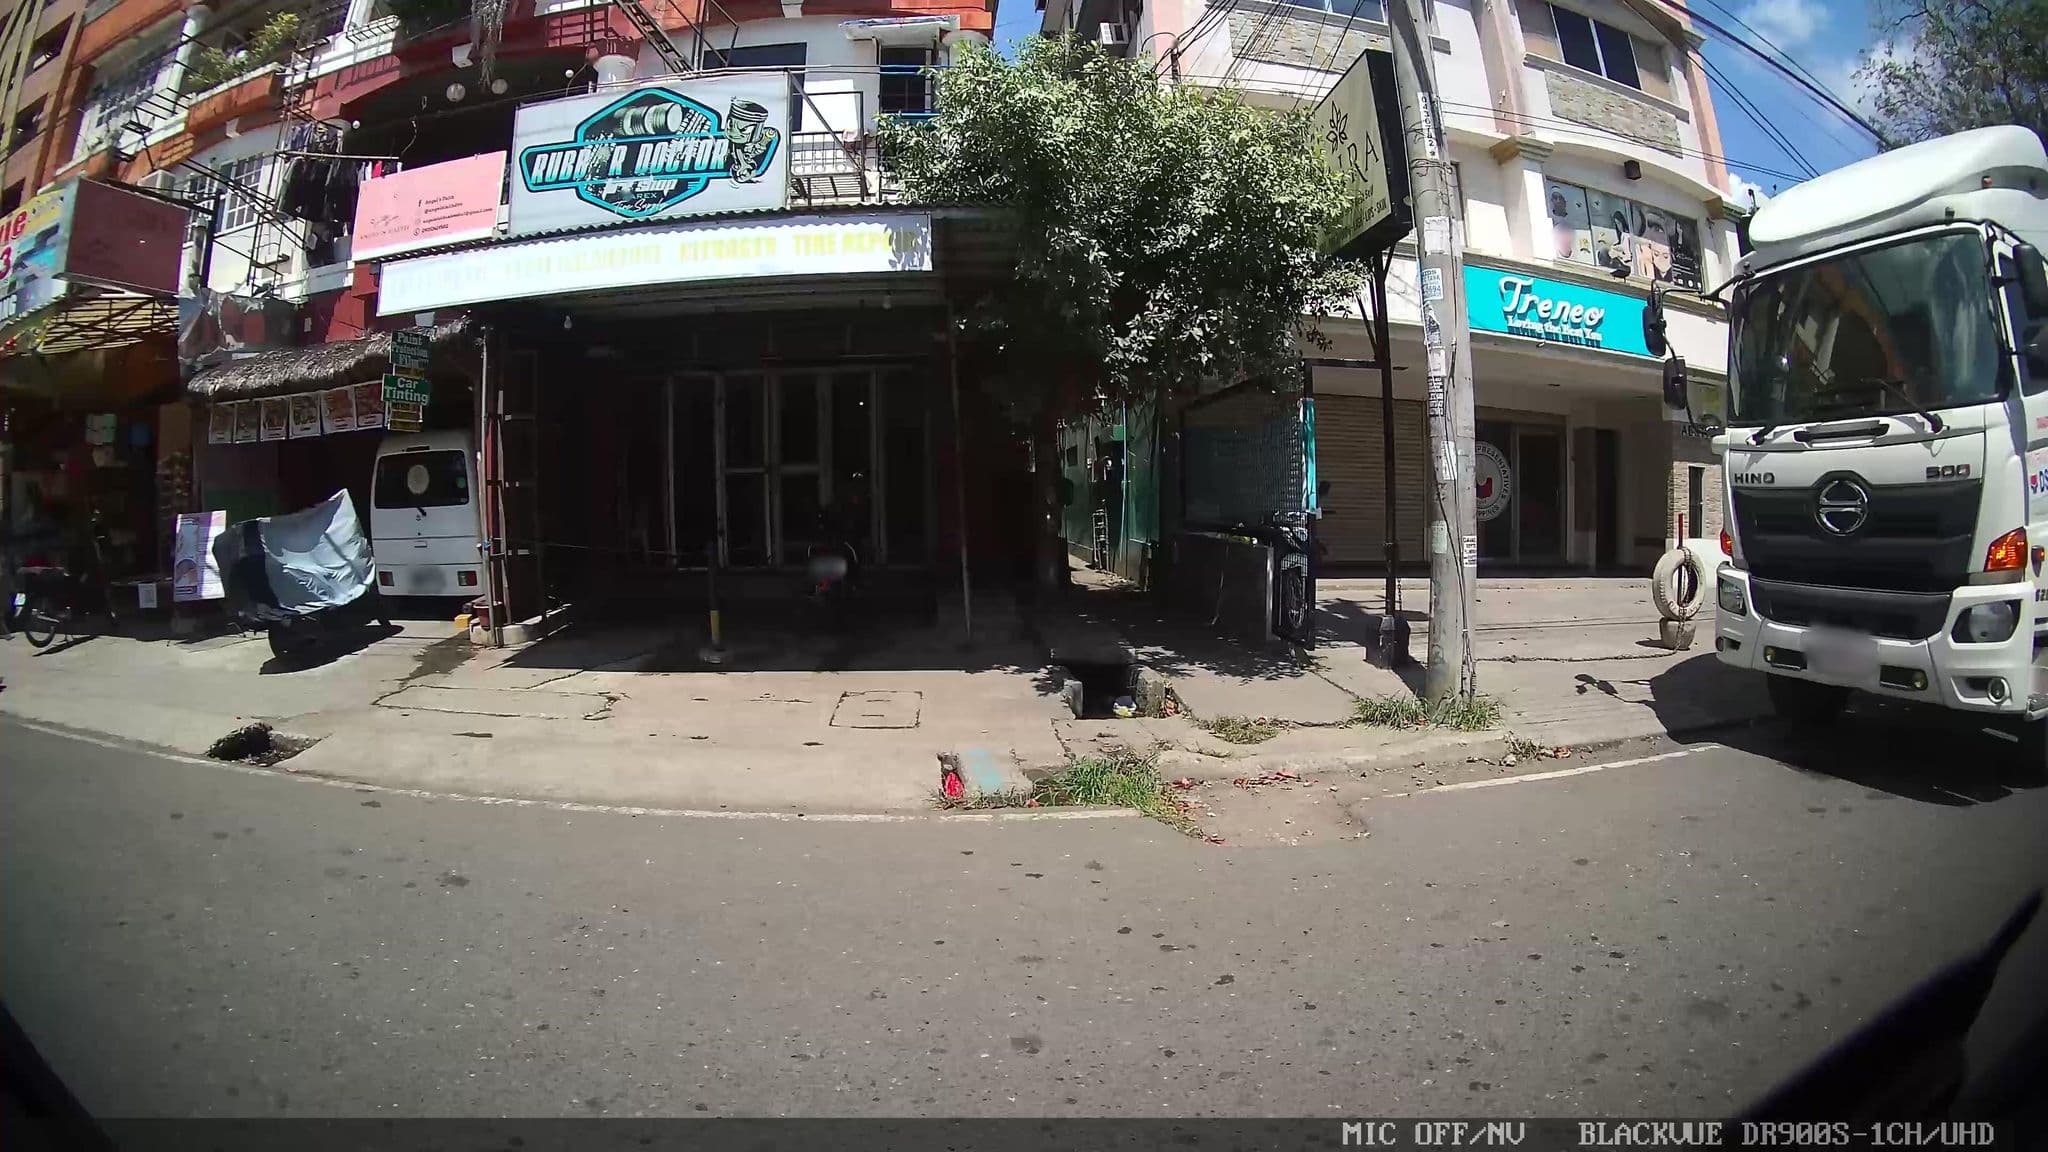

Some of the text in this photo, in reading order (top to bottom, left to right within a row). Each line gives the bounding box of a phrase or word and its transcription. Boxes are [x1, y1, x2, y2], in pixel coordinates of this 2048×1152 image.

[634, 137, 730, 175] DOCTOR
[397, 377, 419, 389] Car
[384, 385, 430, 406] Tinting
[1734, 472, 1776, 484] HINO
[1926, 463, 1971, 480] 500
